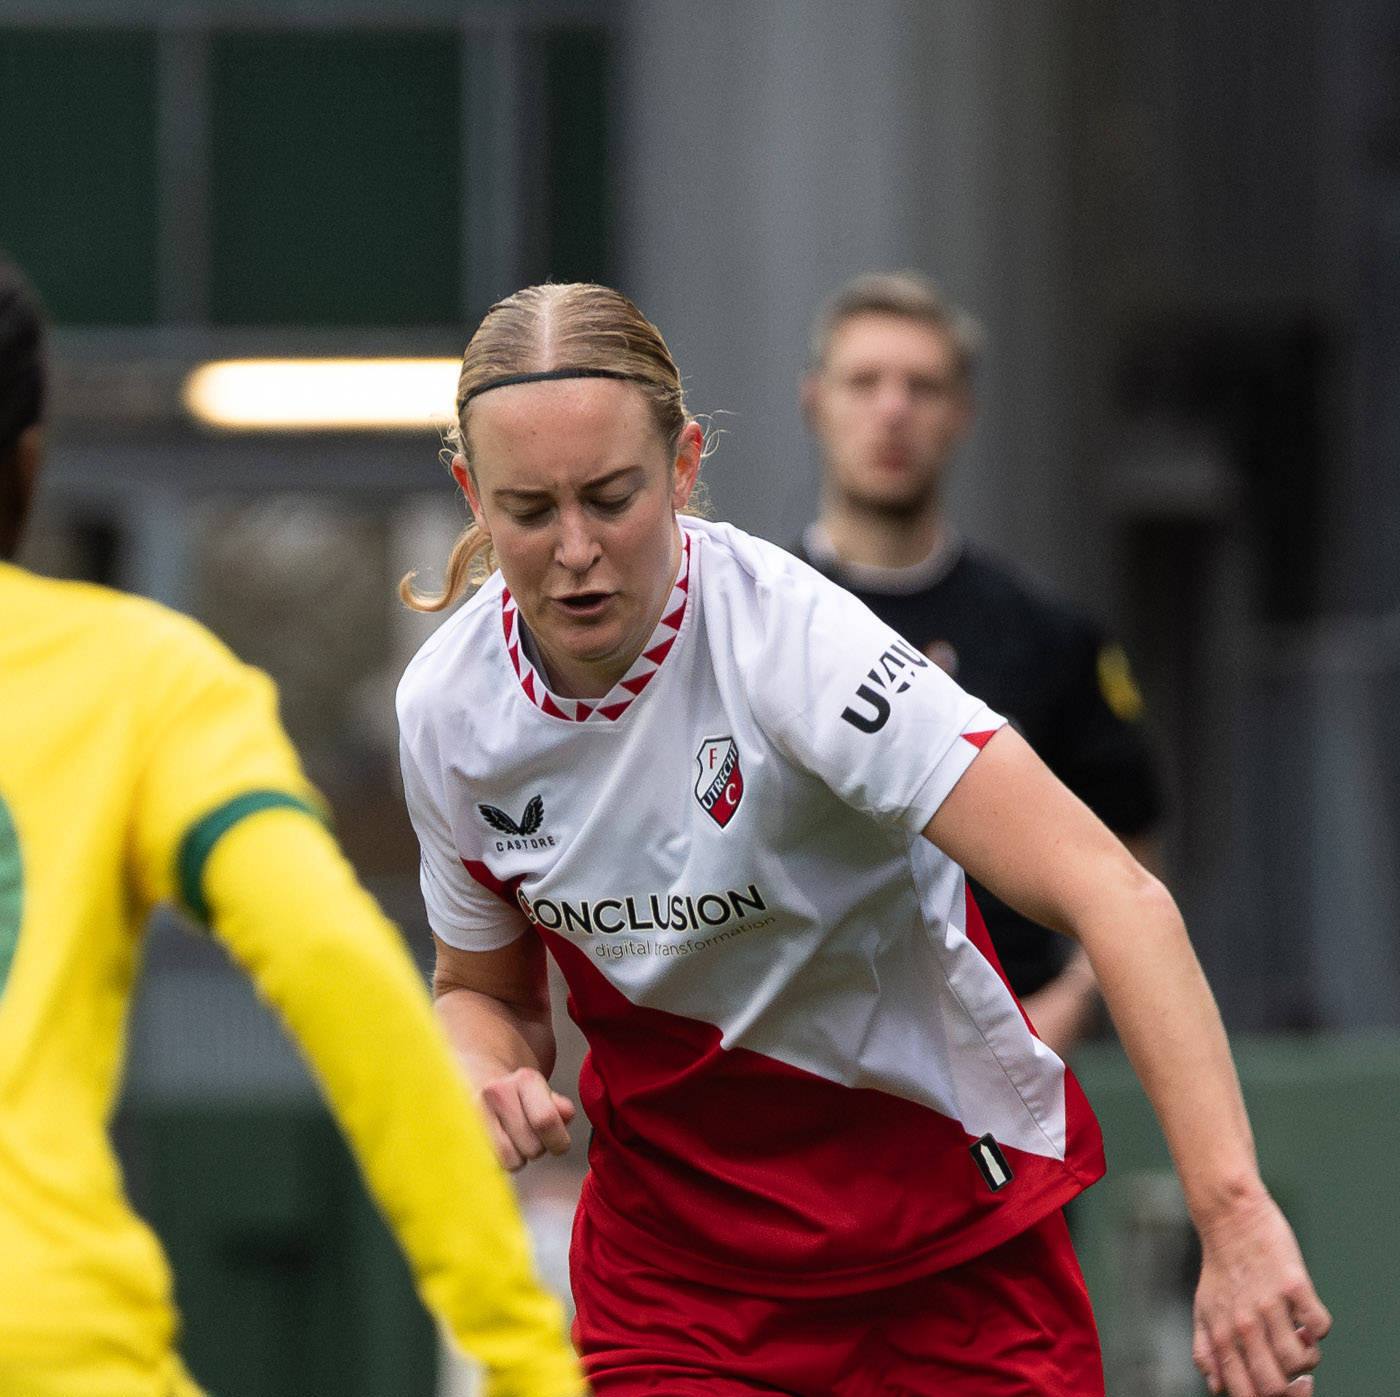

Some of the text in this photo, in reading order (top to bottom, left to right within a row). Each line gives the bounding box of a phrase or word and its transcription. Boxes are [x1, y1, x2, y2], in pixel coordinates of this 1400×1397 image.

[709, 747, 718, 770] F
[701, 742, 738, 810] UTRECHT
[725, 782, 737, 805] C
[495, 834, 557, 852] CASTORE
[594, 914, 777, 959] digital transformation
